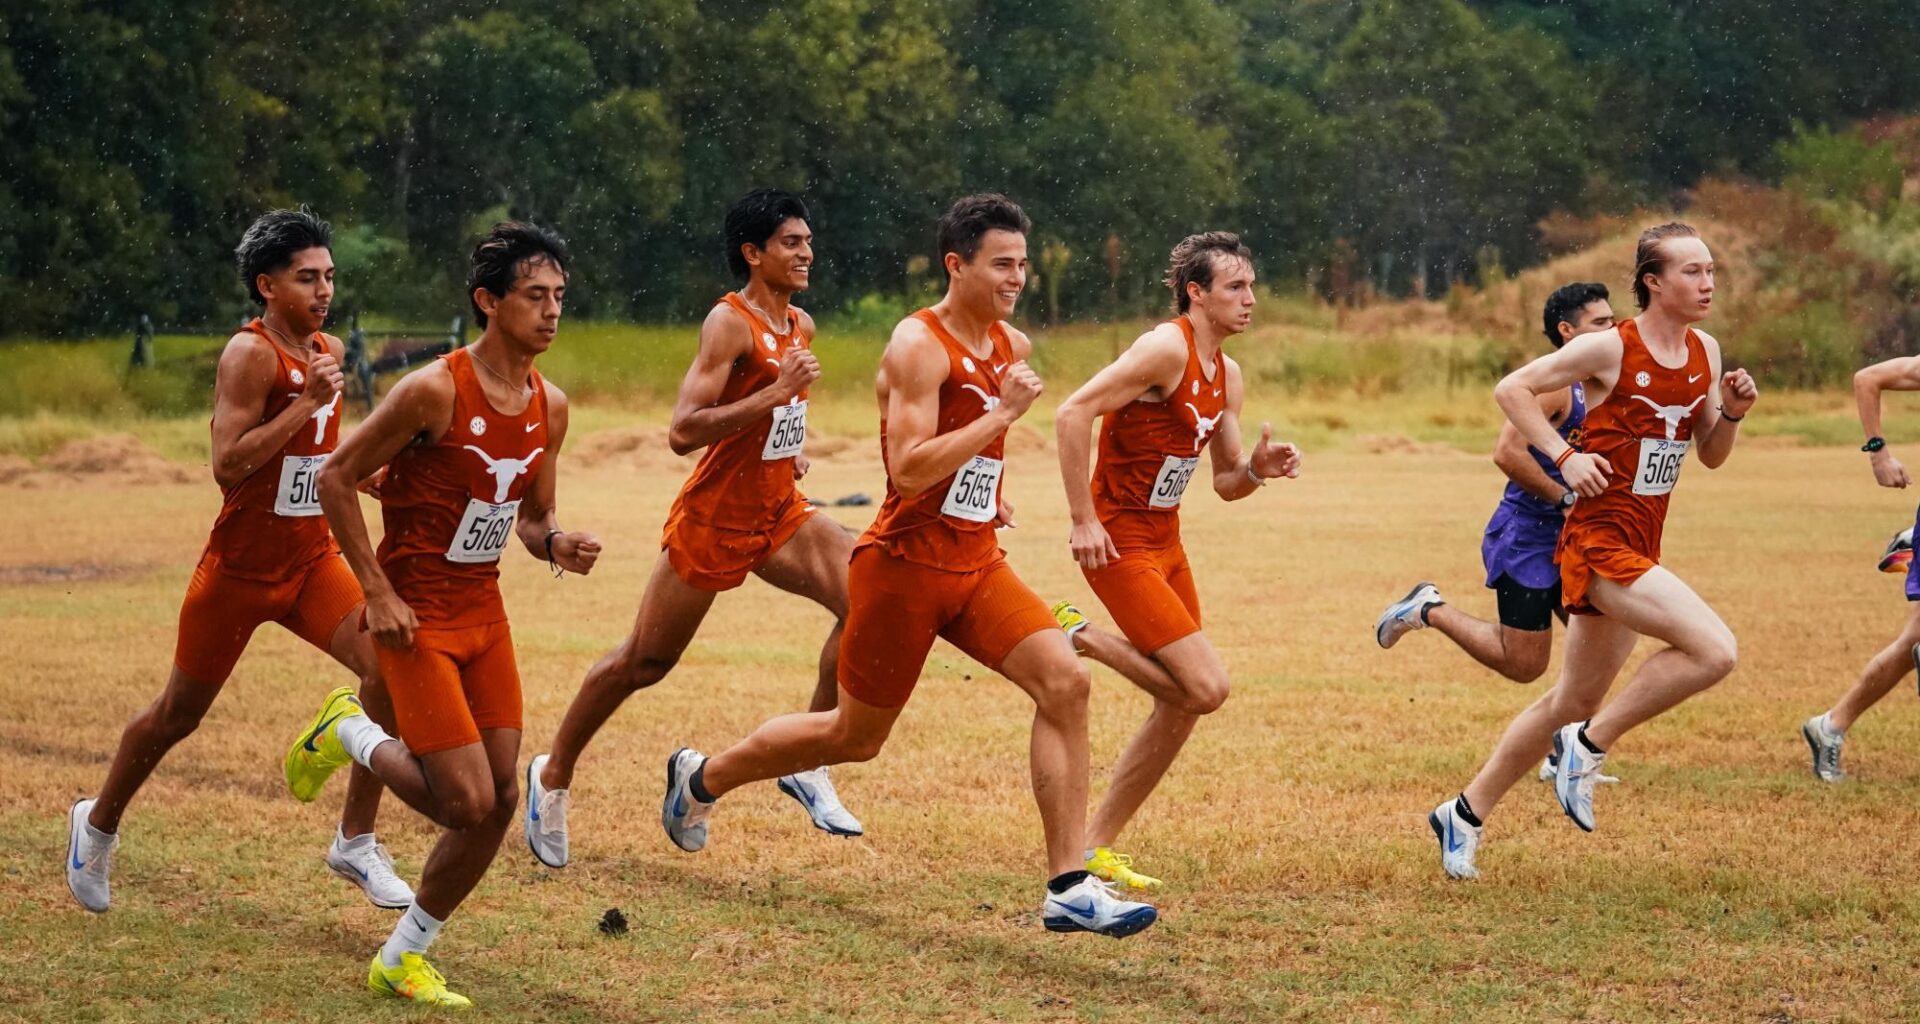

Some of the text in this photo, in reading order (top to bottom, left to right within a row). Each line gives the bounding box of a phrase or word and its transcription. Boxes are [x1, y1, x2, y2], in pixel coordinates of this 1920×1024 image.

[773, 415, 804, 449] 5156
[1644, 453, 1684, 484] 5165
[955, 470, 995, 509] 5155
[463, 516, 514, 551] 5160
